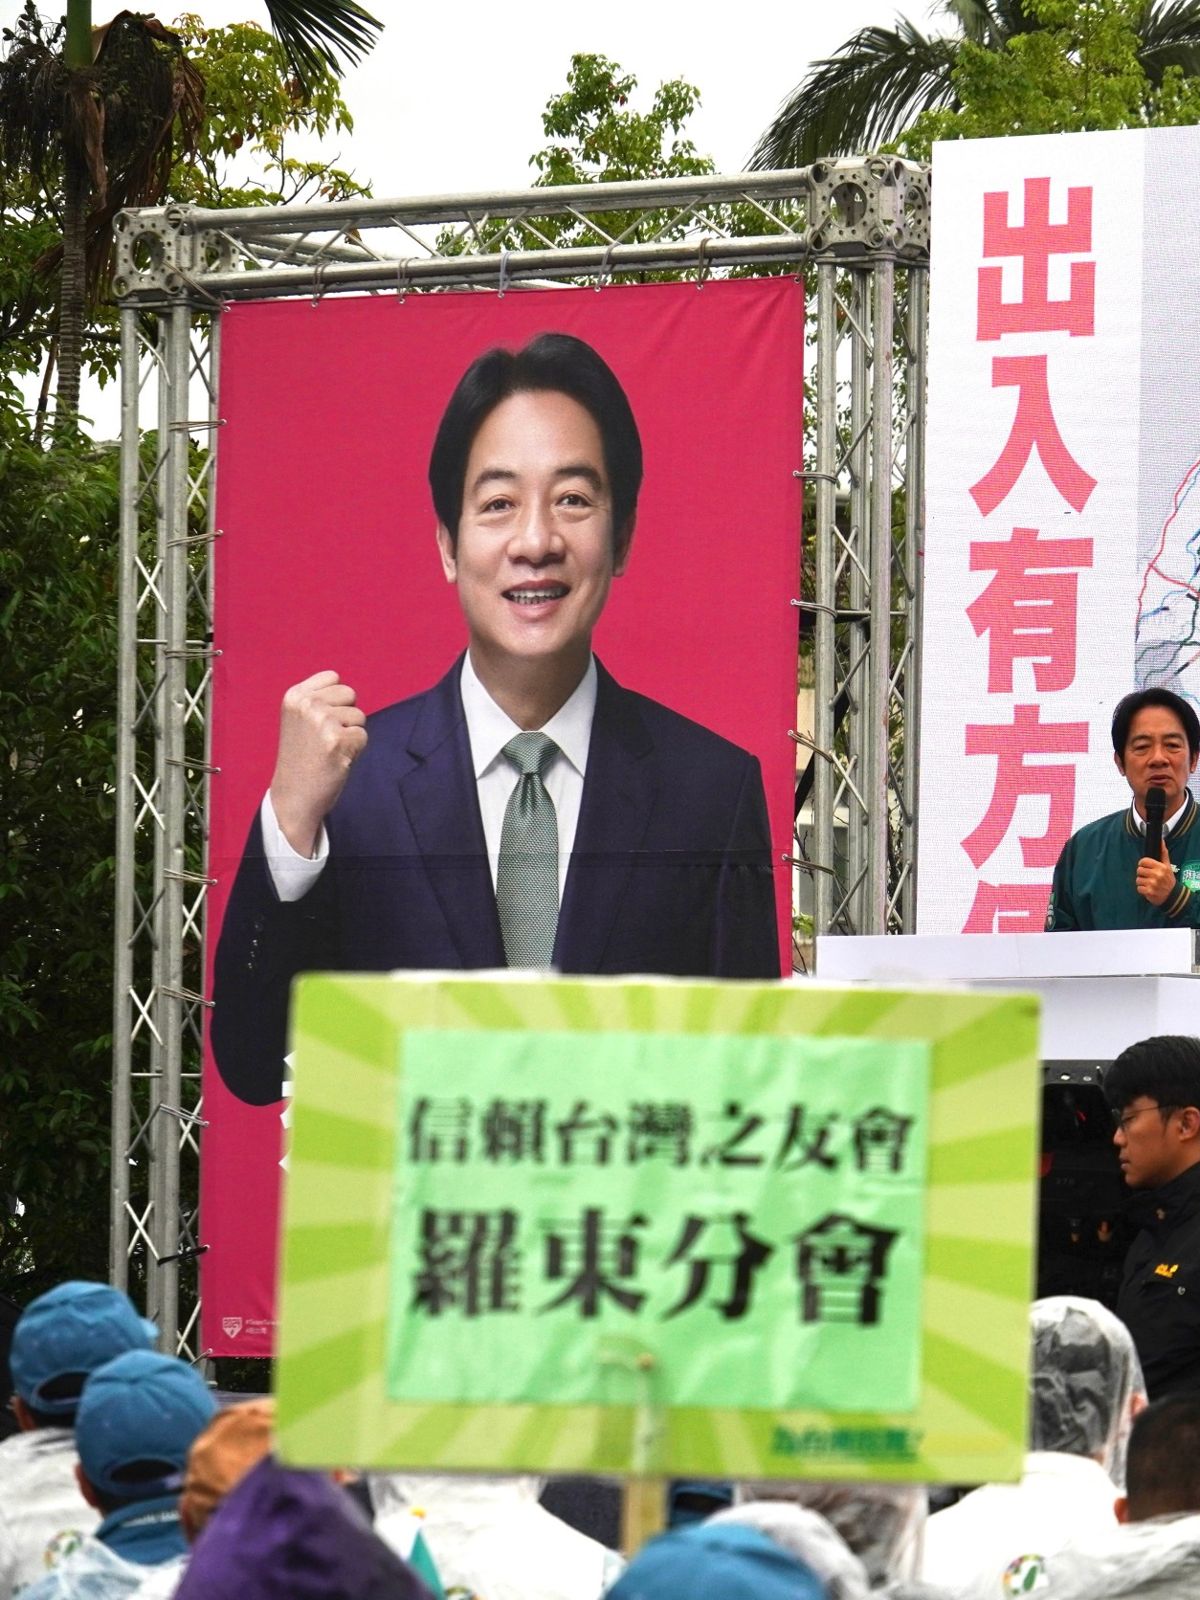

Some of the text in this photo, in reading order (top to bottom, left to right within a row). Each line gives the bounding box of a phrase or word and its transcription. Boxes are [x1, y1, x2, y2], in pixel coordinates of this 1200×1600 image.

[408, 1096, 917, 1176] 信賴台灣之友會
[409, 1205, 904, 1328] 羅東分會
